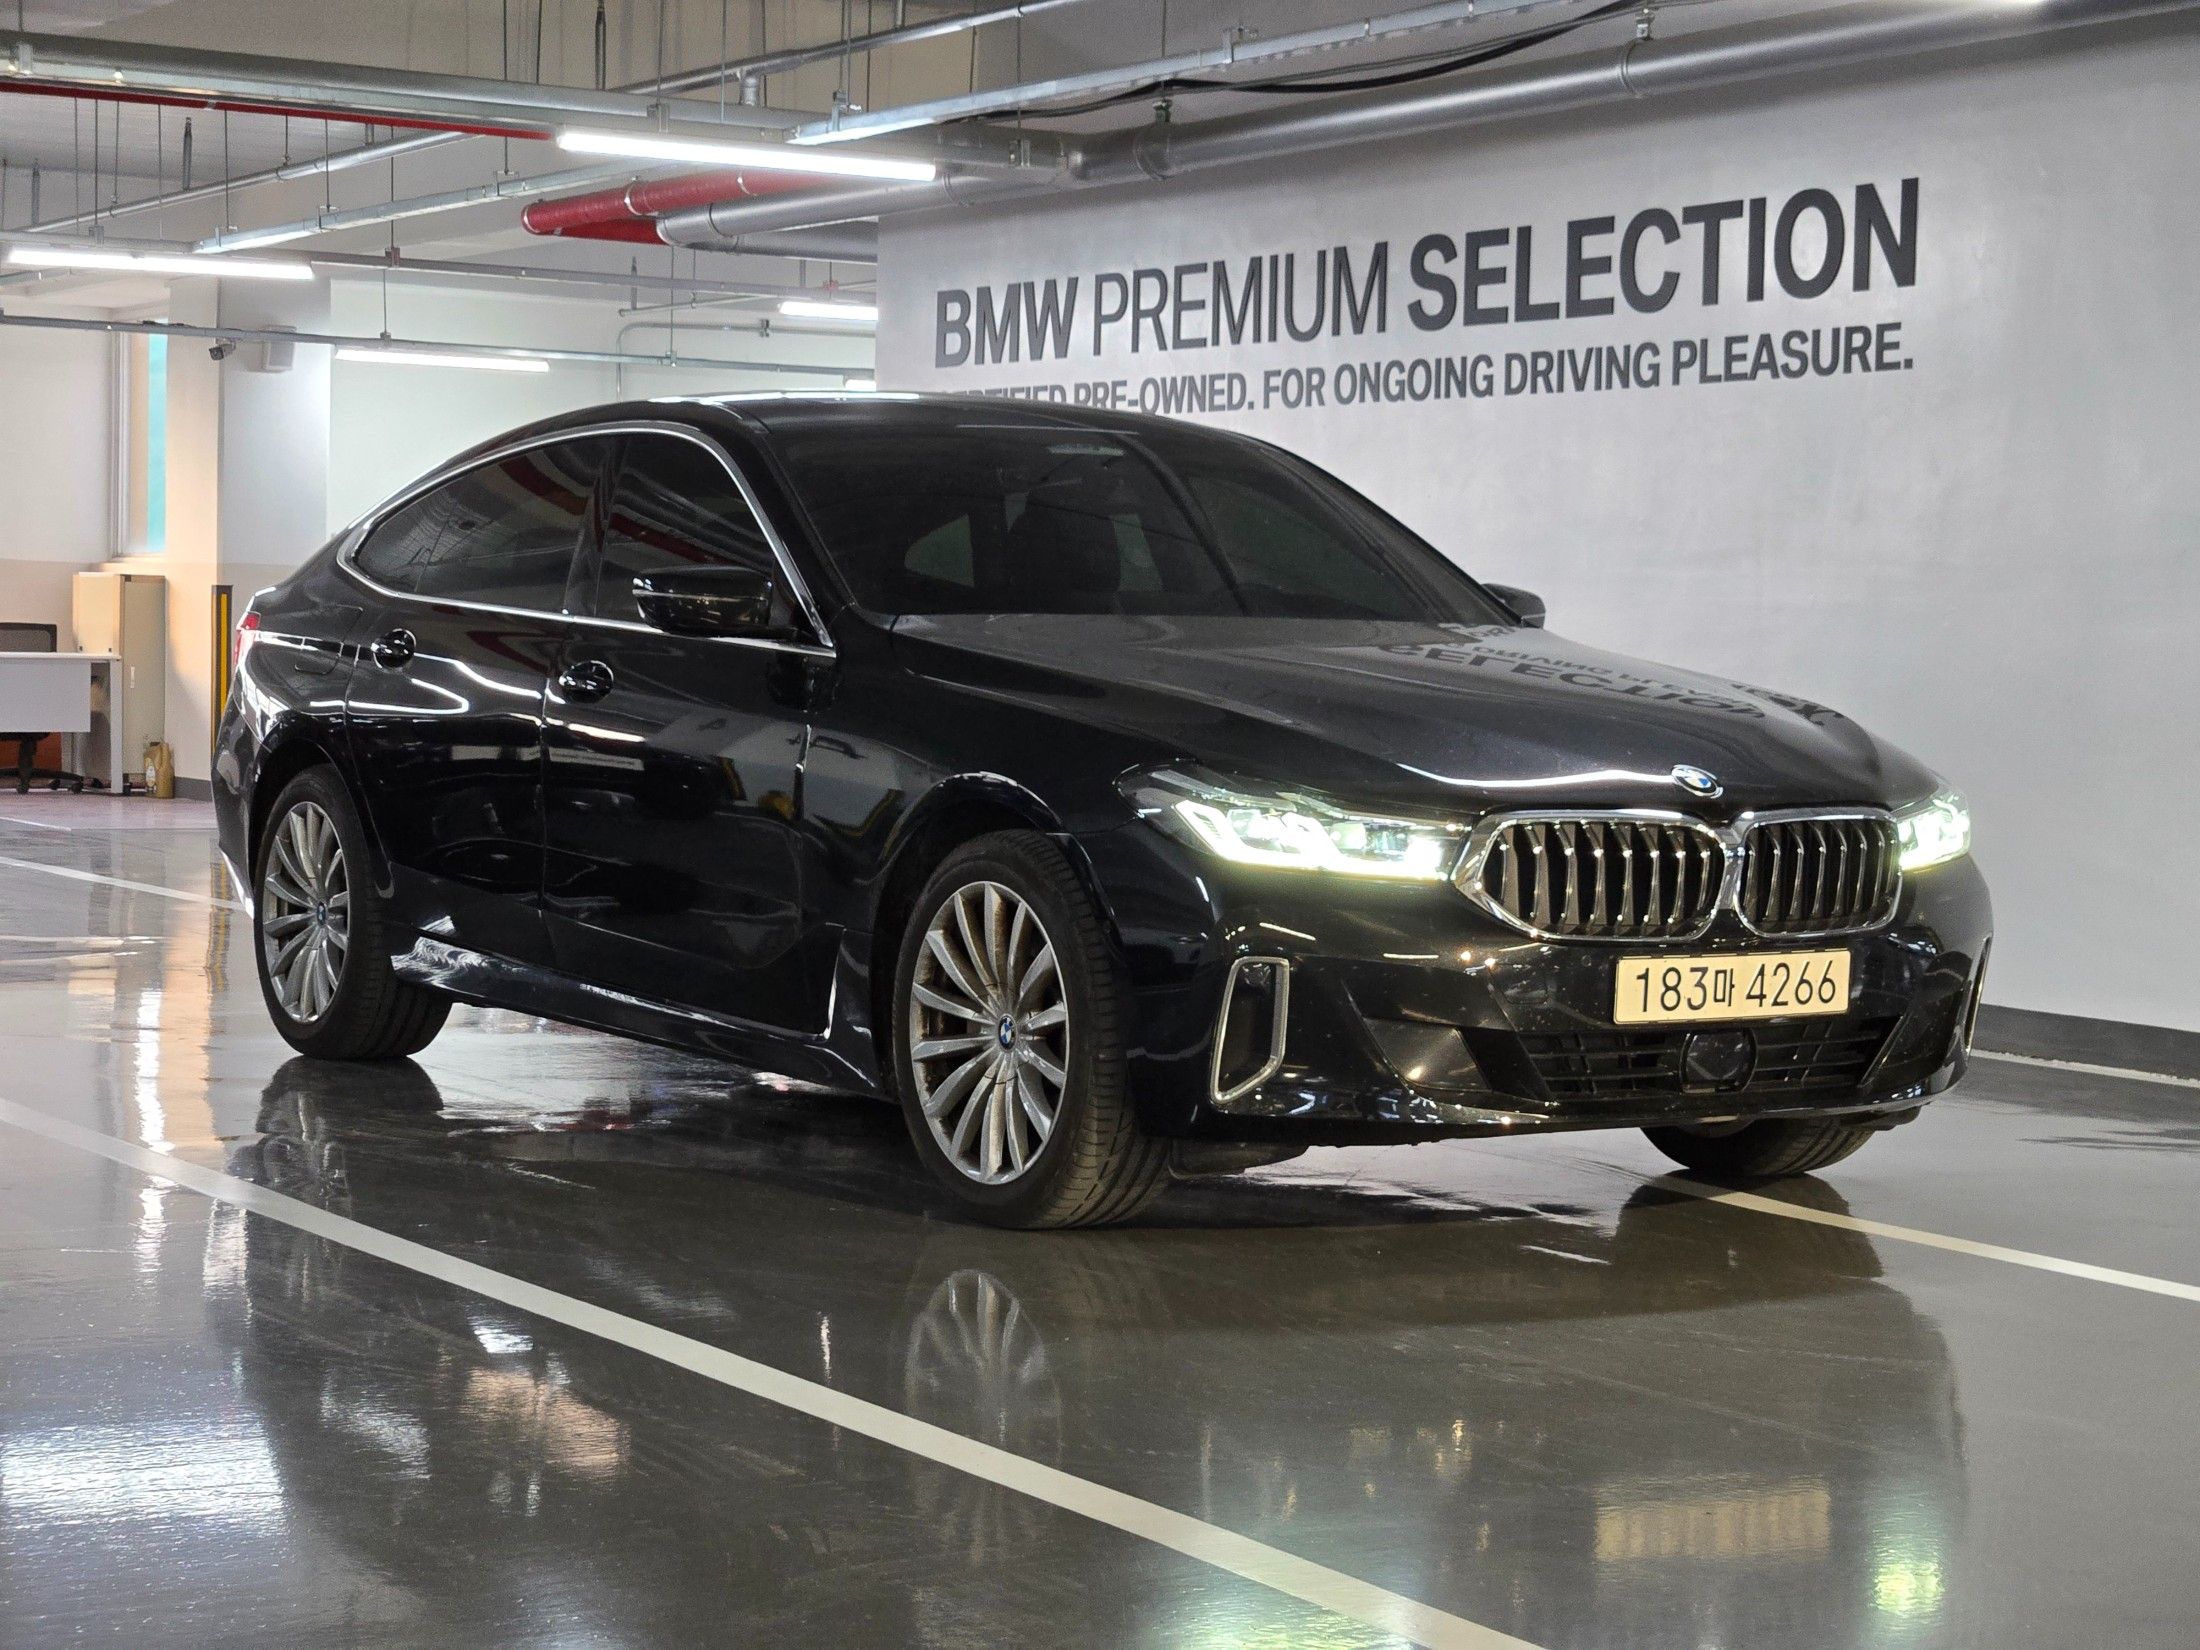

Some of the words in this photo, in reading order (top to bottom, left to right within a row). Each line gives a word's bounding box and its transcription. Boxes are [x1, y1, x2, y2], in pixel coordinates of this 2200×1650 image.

[935, 276, 1079, 368] BMW
[1093, 241, 1389, 356] PREMIUM
[1406, 177, 1919, 331] SELECTION
[1263, 368, 1325, 409] FOR
[1333, 354, 1494, 405] ONGOING
[1503, 341, 1660, 396] DRIVING
[1672, 322, 1913, 385] PLEASURE.
[1745, 960, 1836, 1008] 4266
